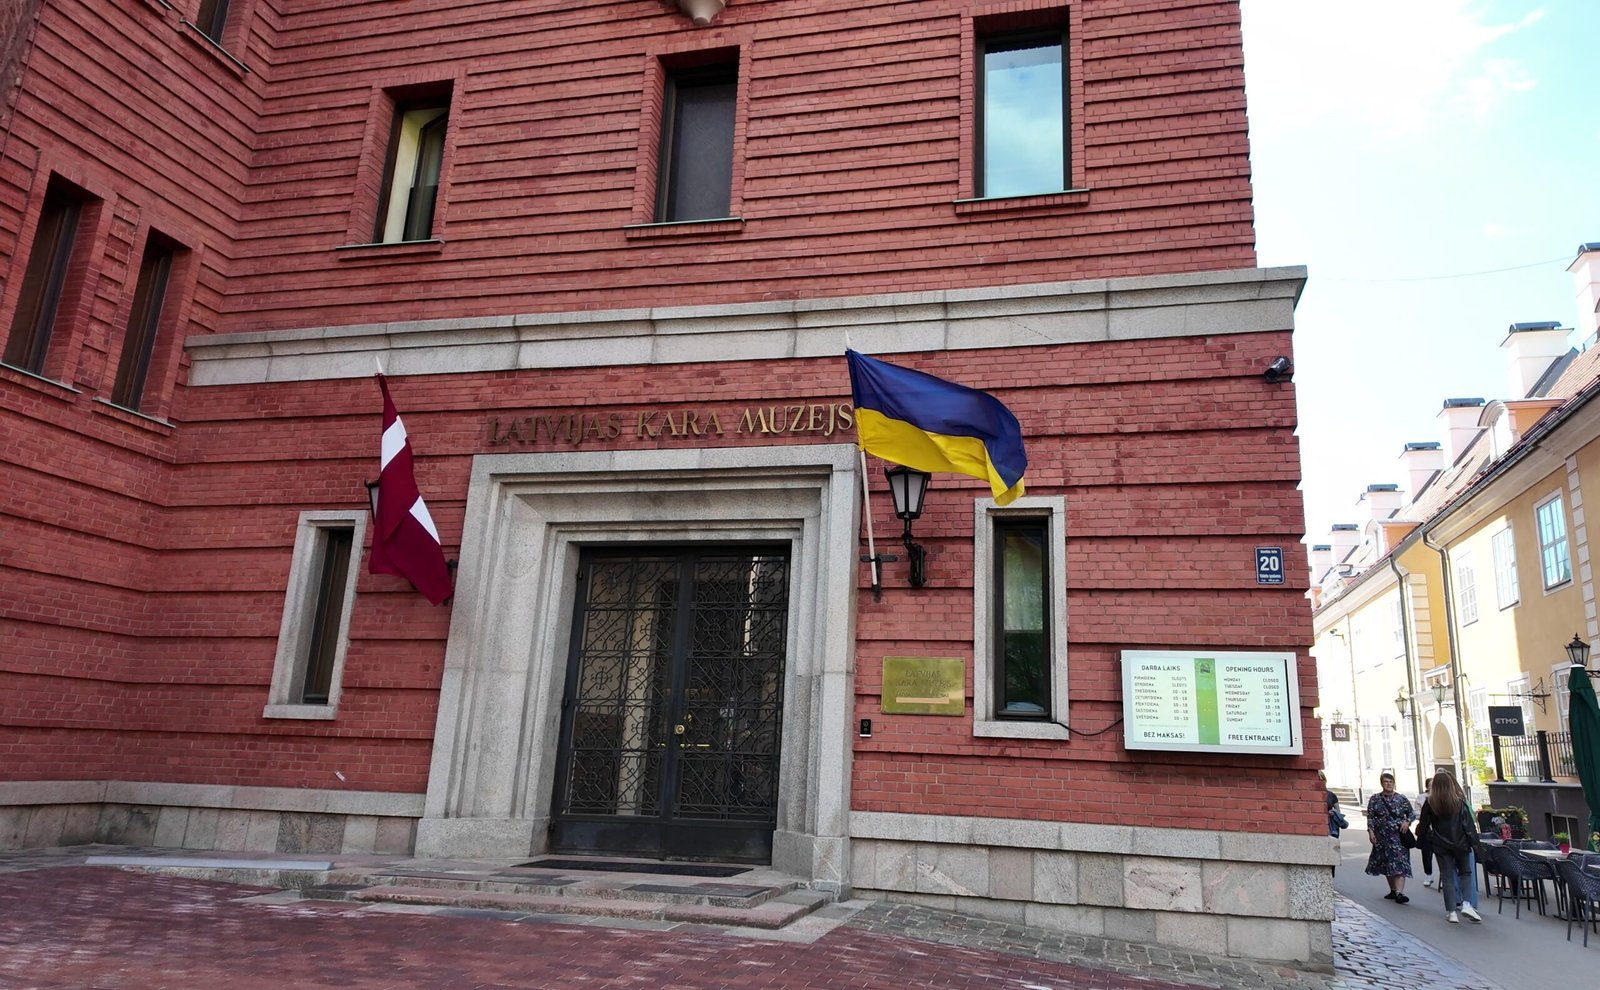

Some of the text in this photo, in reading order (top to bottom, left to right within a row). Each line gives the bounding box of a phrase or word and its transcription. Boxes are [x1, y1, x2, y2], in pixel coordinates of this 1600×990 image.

[488, 403, 854, 446] LATVIJAS KARA MUZEJS
[1260, 556, 1279, 571] 20
